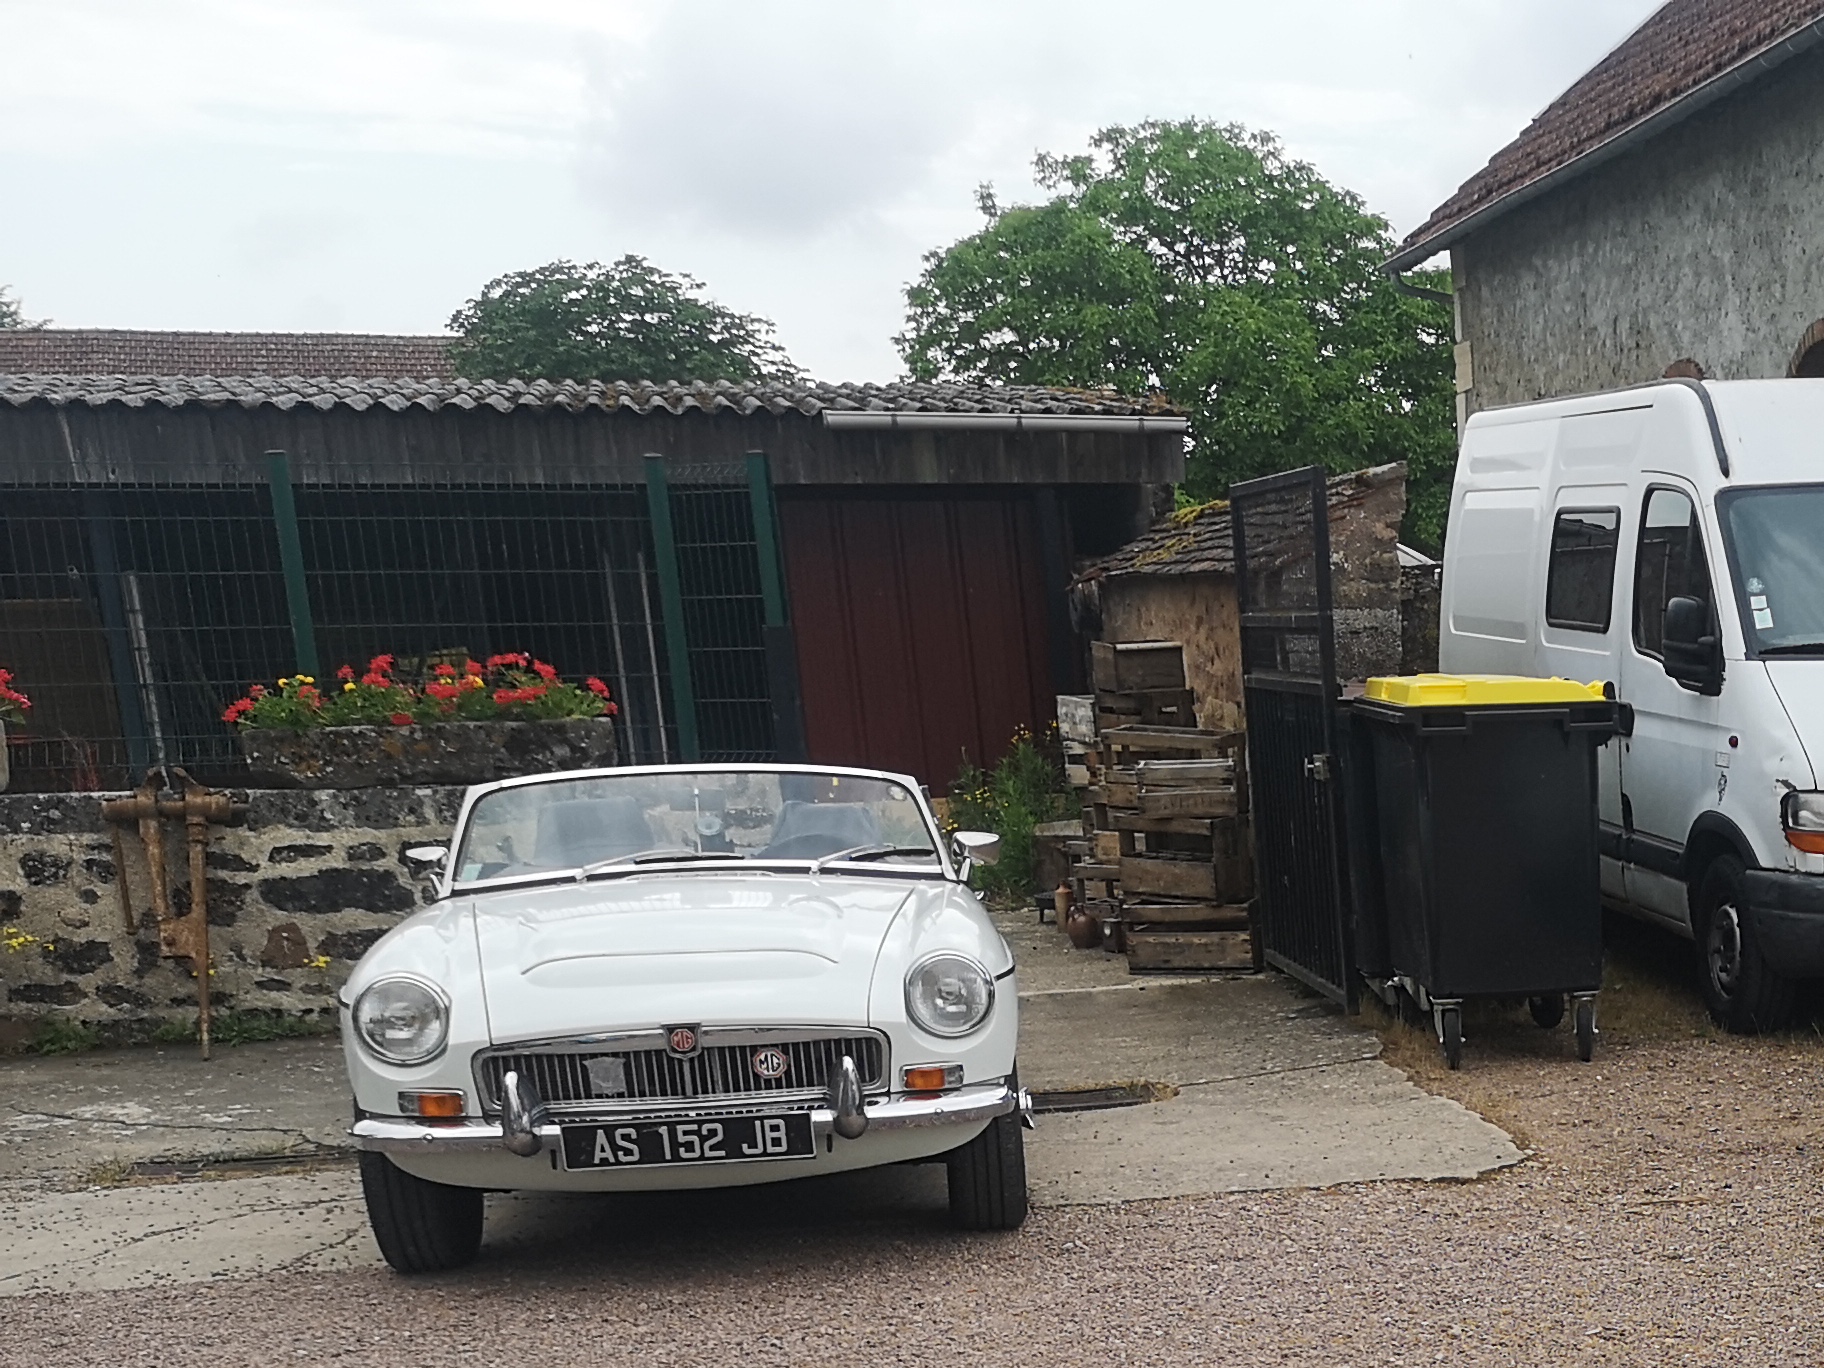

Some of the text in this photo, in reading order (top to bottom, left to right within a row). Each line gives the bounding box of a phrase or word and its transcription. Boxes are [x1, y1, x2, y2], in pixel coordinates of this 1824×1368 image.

[673, 1031, 692, 1049] MG
[759, 1052, 781, 1073] MG
[593, 1118, 788, 1164] AS 152 JB
